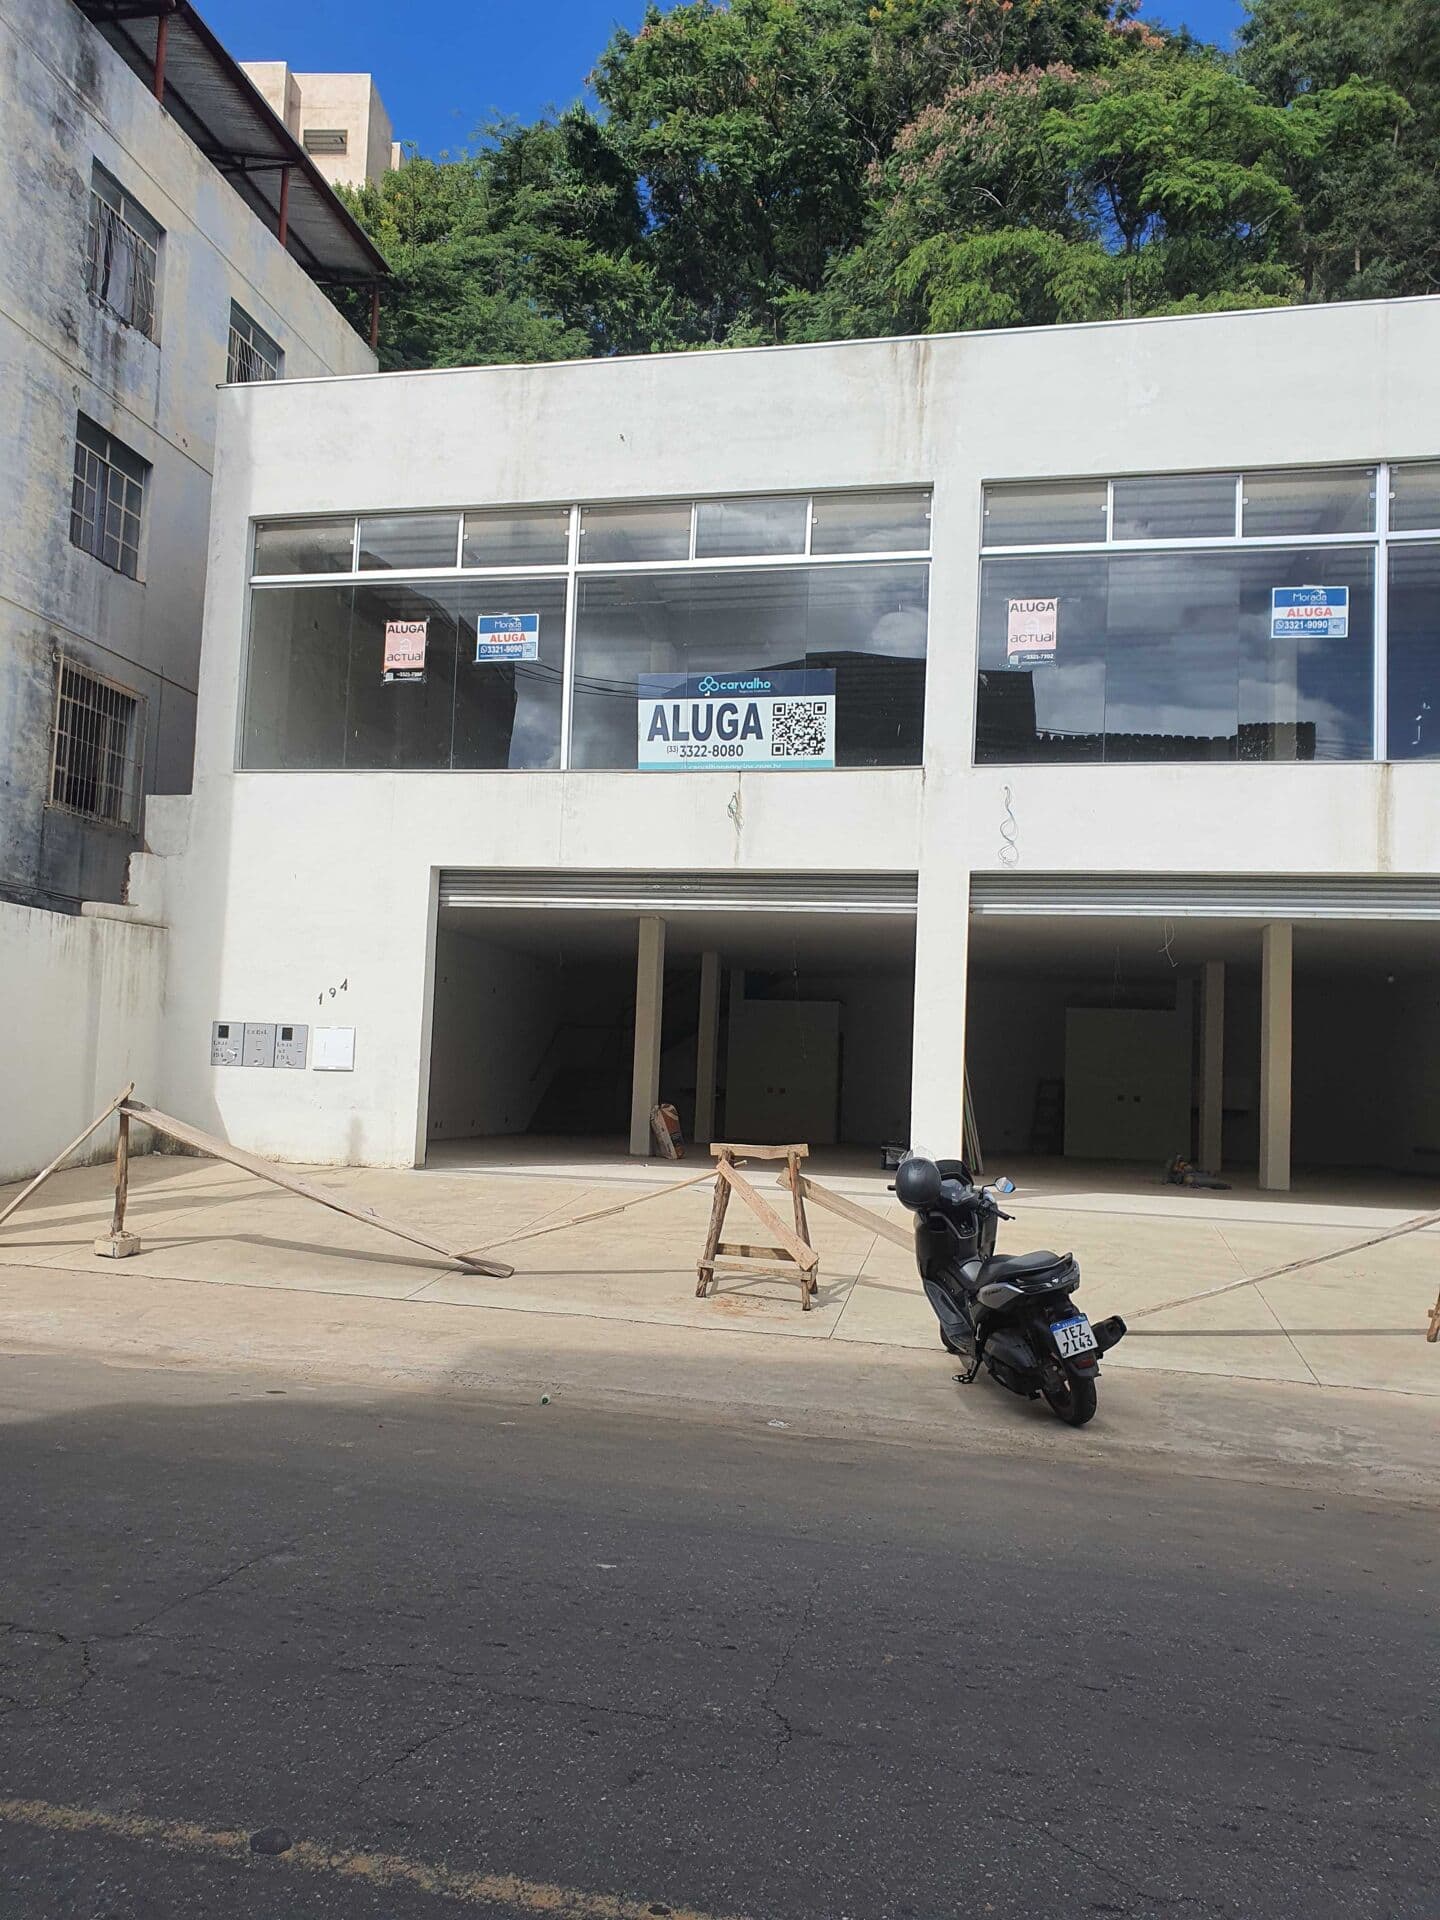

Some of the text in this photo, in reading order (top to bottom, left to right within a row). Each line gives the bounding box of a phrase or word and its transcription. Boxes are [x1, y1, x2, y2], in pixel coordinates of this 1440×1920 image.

[1293, 590, 1327, 602] Morada
[1010, 601, 1055, 612] ALUGA
[1287, 607, 1332, 617] ALUGA
[387, 624, 425, 633] ALUGA
[1284, 620, 1328, 630] 3321-9090
[489, 633, 526, 642] ALUGA
[719, 677, 771, 690] carvalho
[646, 702, 764, 742] ALUGA
[679, 744, 744, 757] 3322-8080
[318, 978, 348, 1005] 194
[1062, 1324, 1085, 1341] TEZ
[1062, 1334, 1093, 1354] 7143
